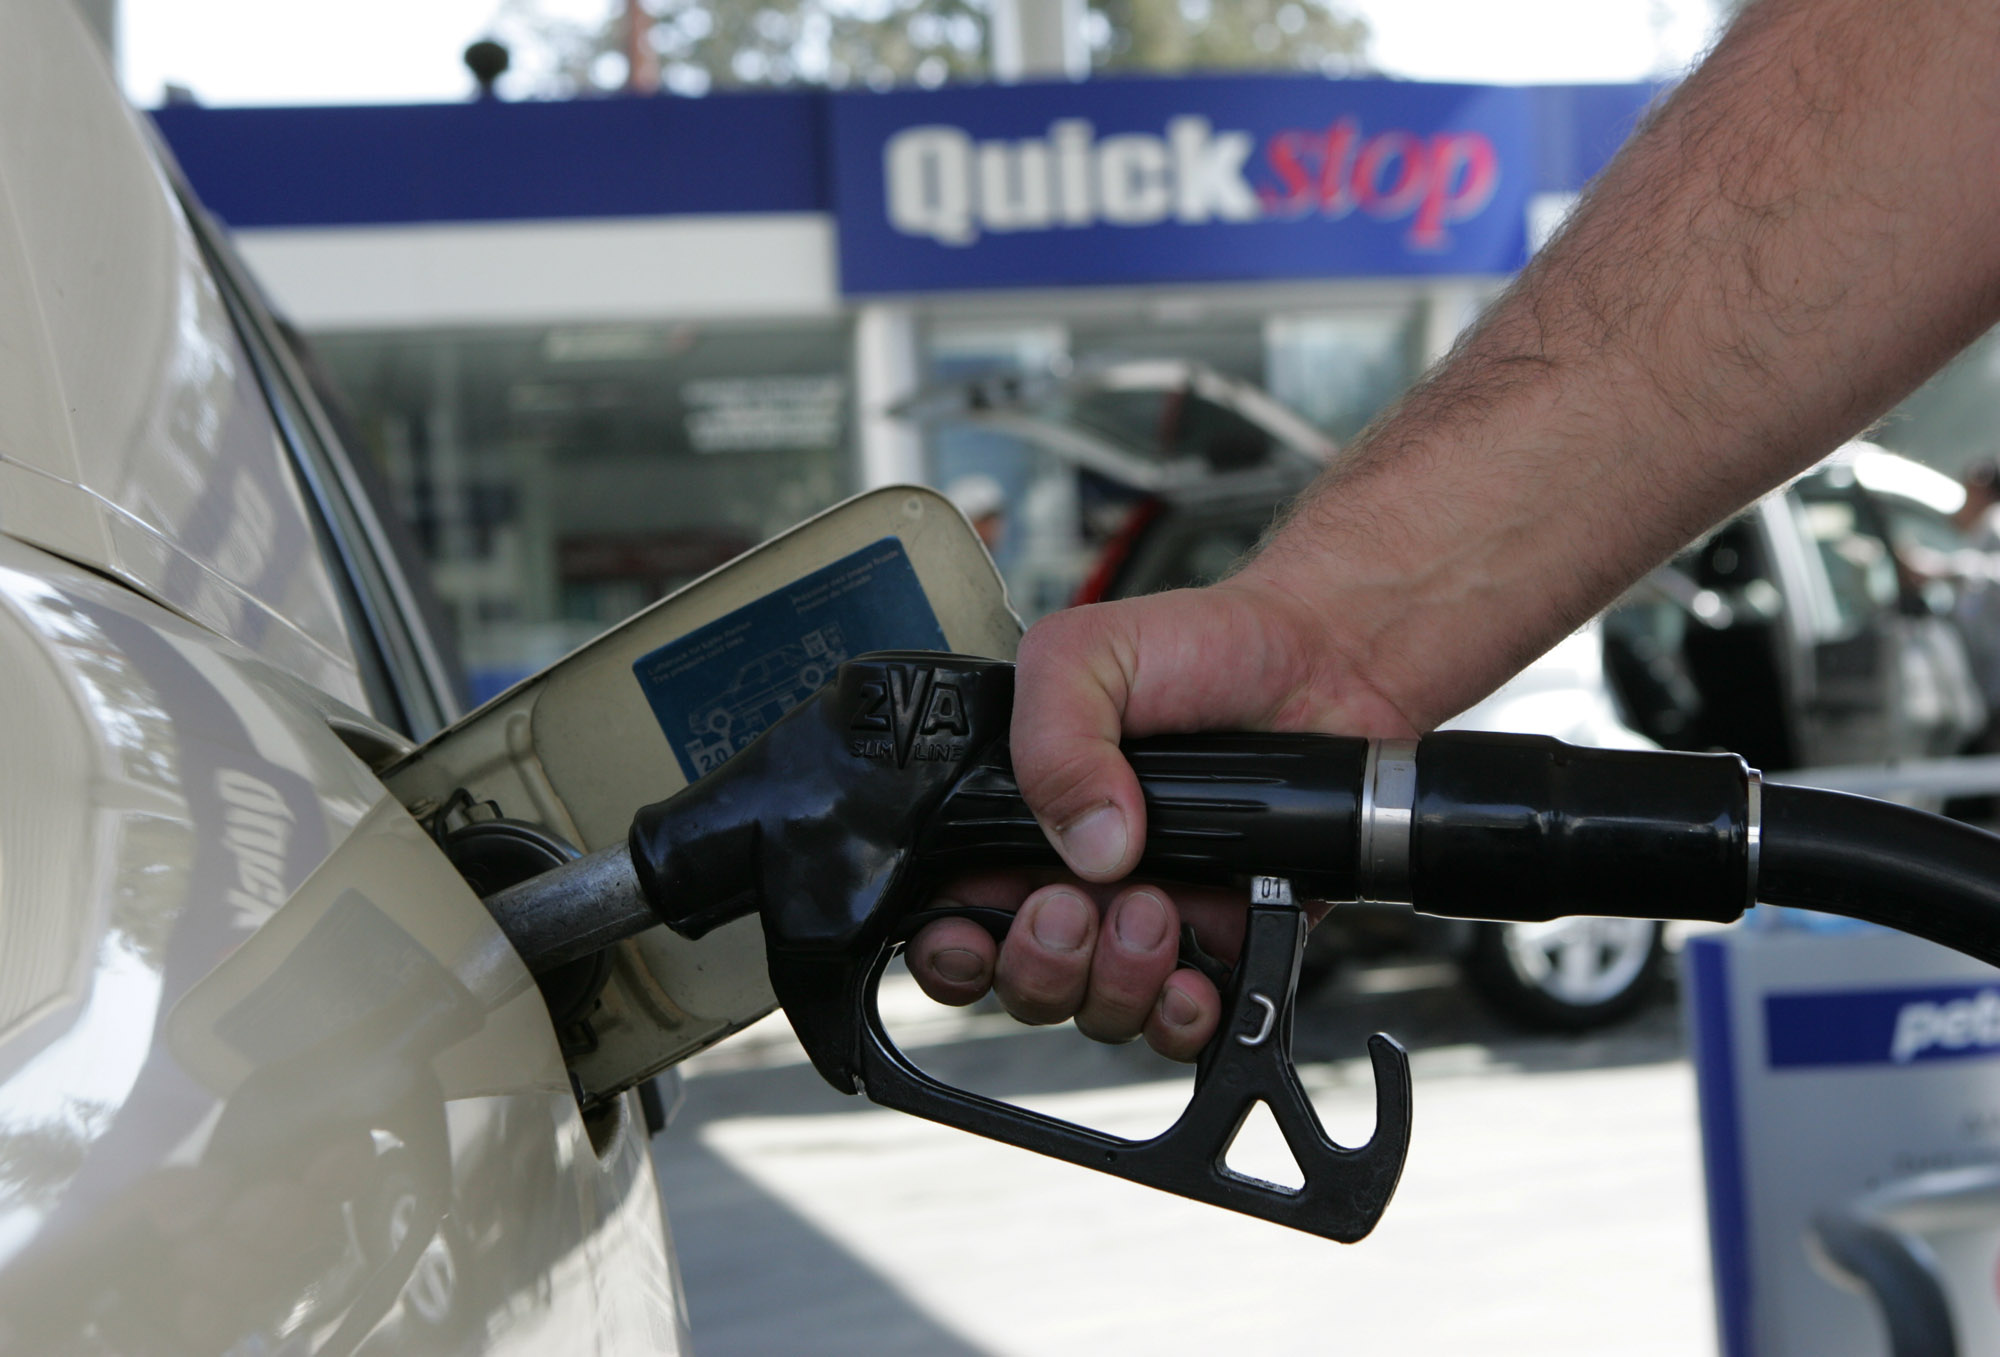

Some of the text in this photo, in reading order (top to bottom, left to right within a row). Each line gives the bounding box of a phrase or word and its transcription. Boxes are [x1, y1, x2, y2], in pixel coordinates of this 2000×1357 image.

[850, 740, 894, 759] SLIM
[1261, 877, 1281, 899] 01
[1892, 986, 2000, 1063] pet
